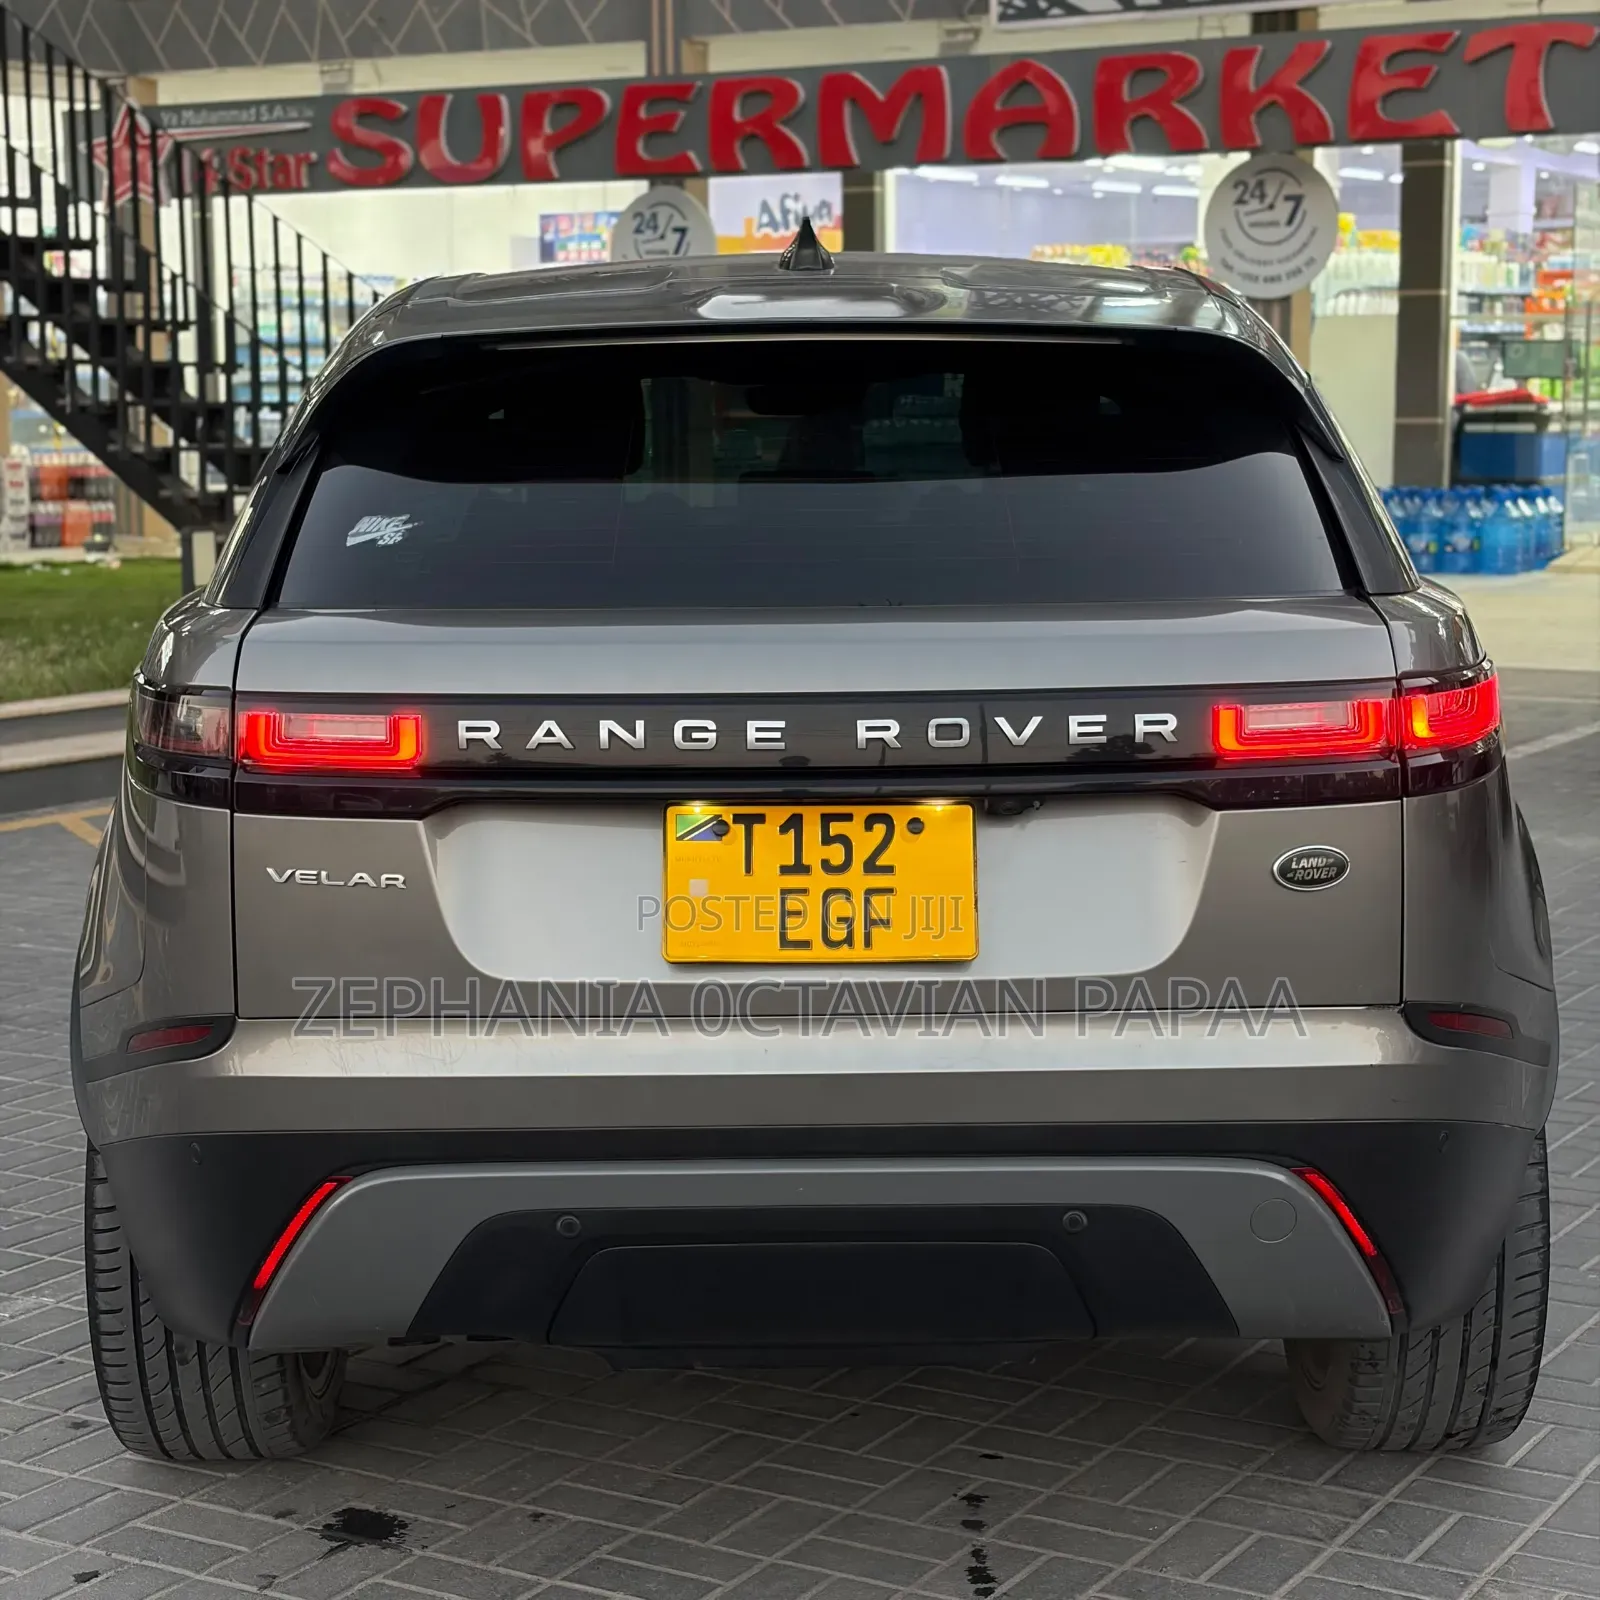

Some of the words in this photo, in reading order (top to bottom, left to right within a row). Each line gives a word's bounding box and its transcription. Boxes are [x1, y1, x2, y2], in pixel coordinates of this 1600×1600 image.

[325, 21, 1599, 187] SUPERMARKET
[457, 719, 787, 750] RANGE
[856, 713, 1178, 749] ROVER
[732, 812, 896, 876] T152
[1291, 856, 1327, 869] LAND
[265, 867, 407, 889] VELAR
[1294, 866, 1338, 880] ROVER
[778, 887, 897, 950] EGF
